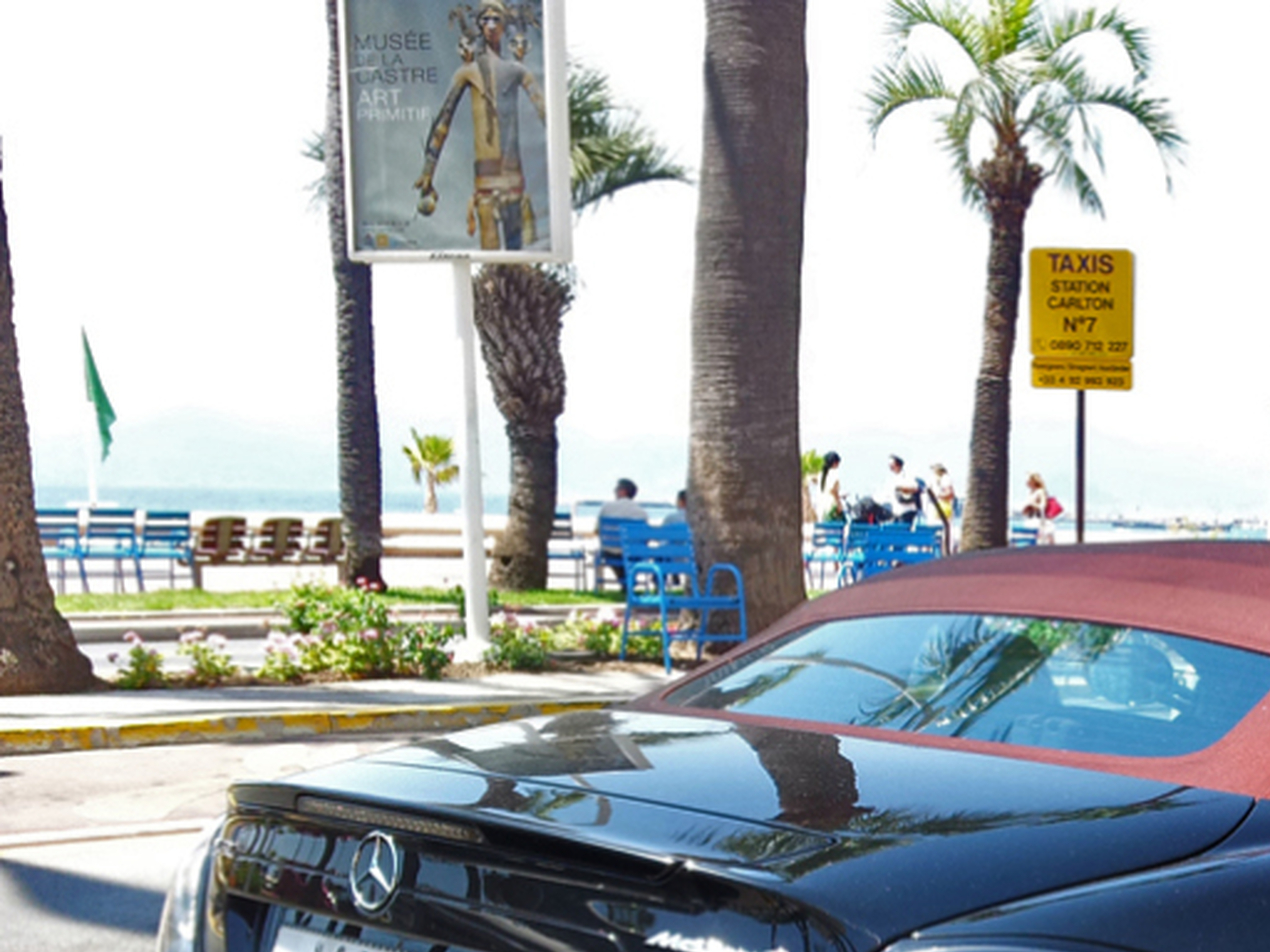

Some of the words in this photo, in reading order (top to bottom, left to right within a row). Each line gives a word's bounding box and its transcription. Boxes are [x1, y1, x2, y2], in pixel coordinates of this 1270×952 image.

[354, 30, 431, 51] MUSÉE
[356, 54, 375, 66] DE
[382, 53, 403, 66] LA
[355, 67, 438, 85] CASTRE
[358, 88, 401, 106] ART
[357, 106, 430, 122] PRIMITIF
[1047, 253, 1114, 274] TAXIS
[1051, 280, 1110, 293] STATION
[1047, 297, 1114, 310] CARLTON
